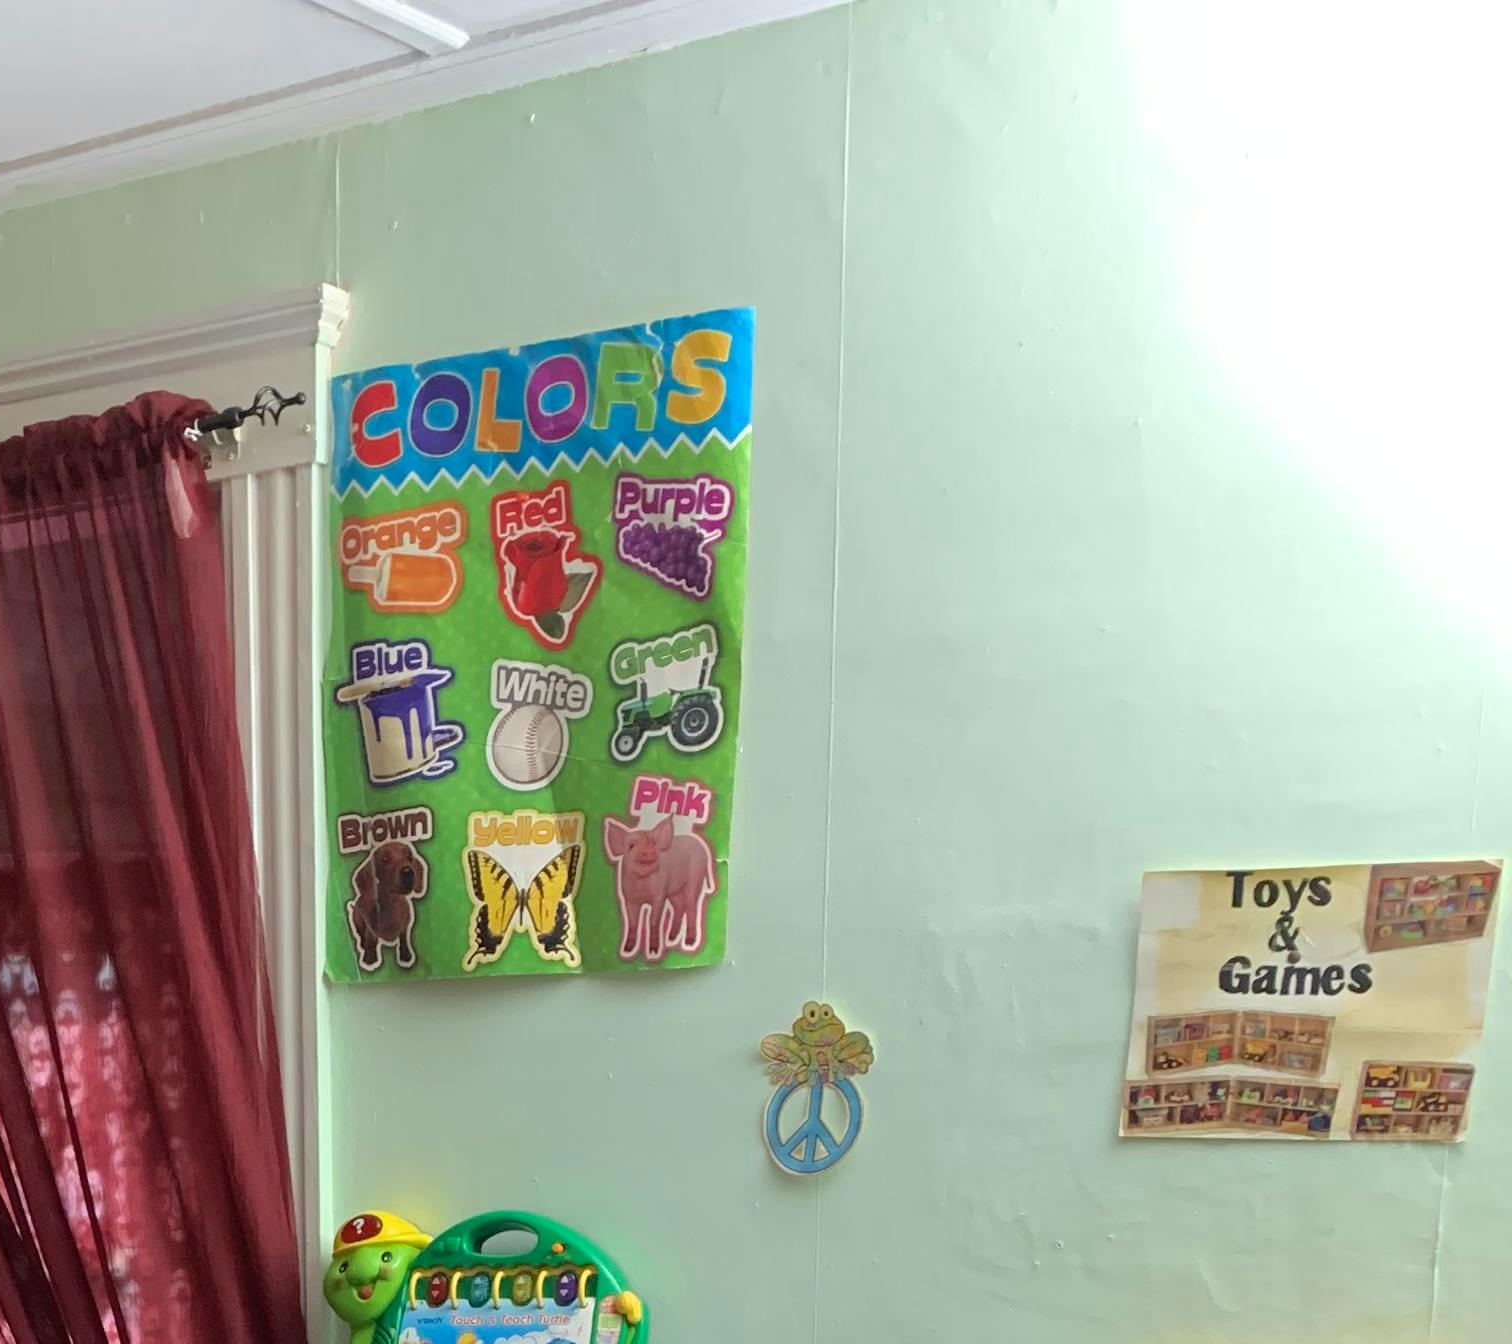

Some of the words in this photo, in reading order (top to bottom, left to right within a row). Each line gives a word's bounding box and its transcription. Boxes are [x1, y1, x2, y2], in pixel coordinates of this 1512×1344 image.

[351, 329, 731, 468] COLORS
[498, 487, 567, 533] Red
[615, 480, 726, 522] Purple
[341, 509, 459, 557] Orange
[354, 643, 424, 680] Blue
[614, 628, 715, 678] Green
[497, 669, 587, 711] White
[631, 782, 712, 818] Pink
[340, 811, 430, 849] Brown
[473, 814, 578, 846] Yellow
[1225, 871, 1333, 914] Toys
[1268, 911, 1300, 952] &
[1219, 956, 1373, 996] Games
[451, 1314, 483, 1326] Touch
[501, 1314, 534, 1325] Teach
[539, 1313, 570, 1325] Turtle
